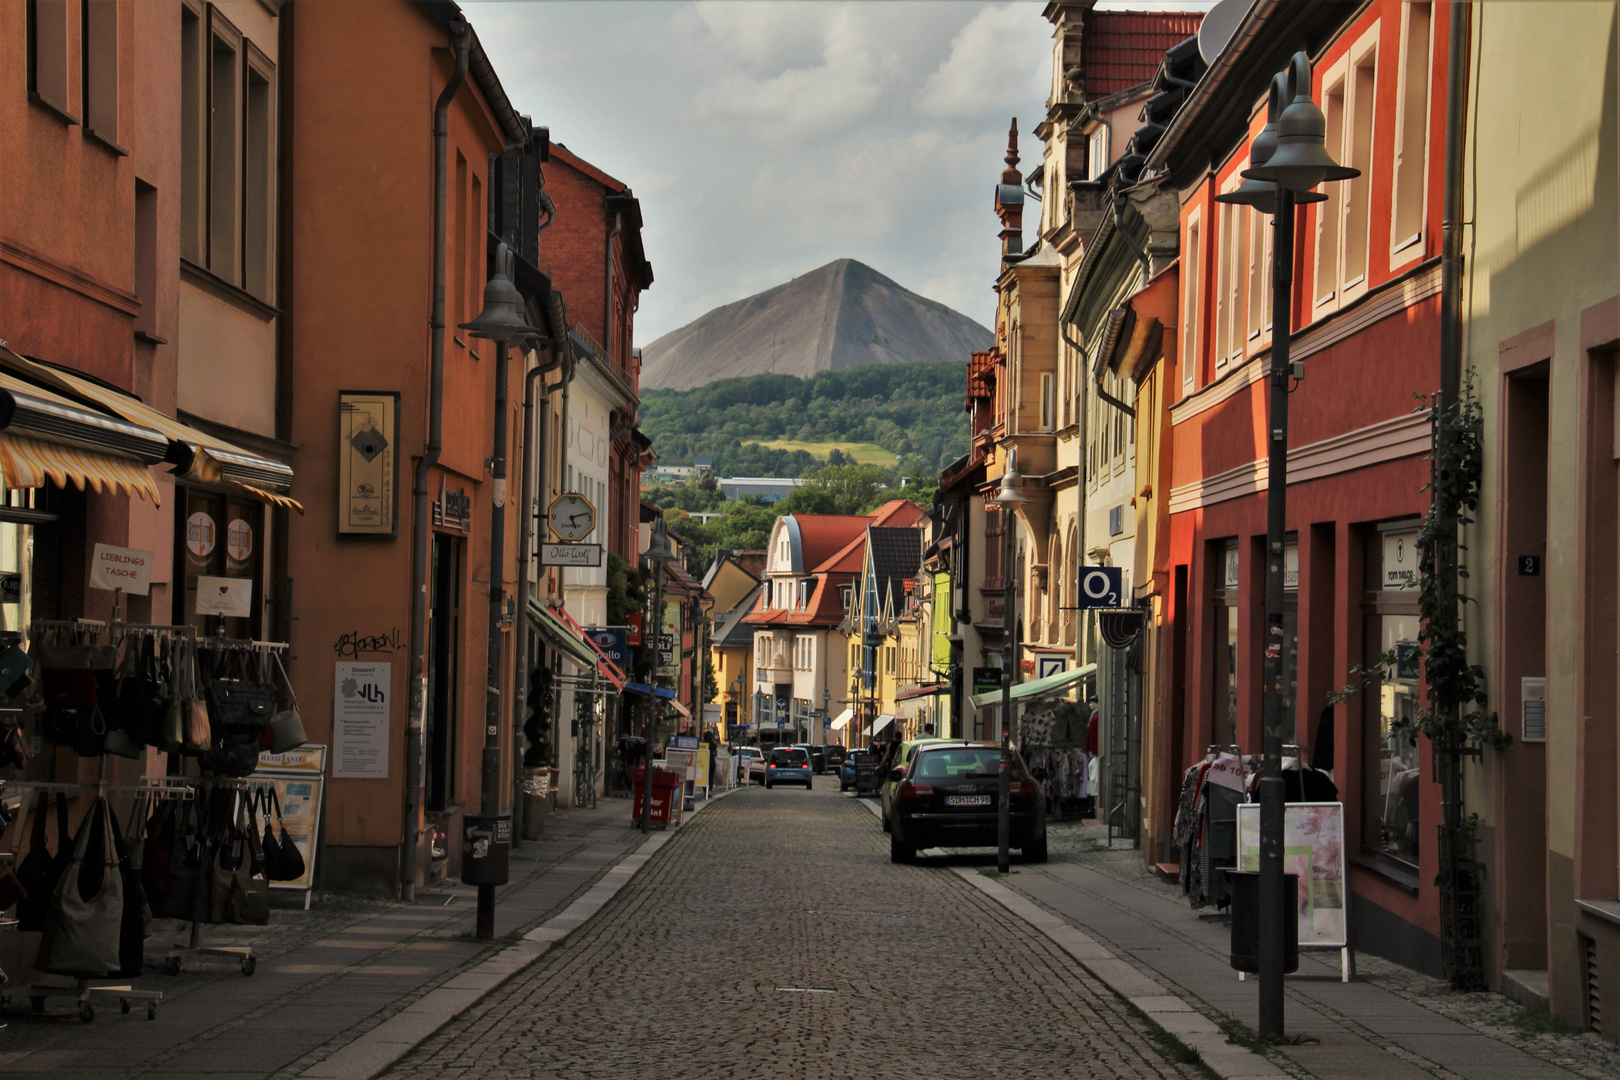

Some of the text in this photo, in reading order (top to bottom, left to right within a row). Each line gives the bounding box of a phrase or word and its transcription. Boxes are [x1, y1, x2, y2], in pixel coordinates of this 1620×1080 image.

[100, 552, 145, 566] LIEBLINGS
[550, 546, 591, 564] Otto Wolf
[105, 566, 138, 579] TASCHE
[1525, 557, 1534, 574] 2
[1213, 763, 1226, 772] ab
